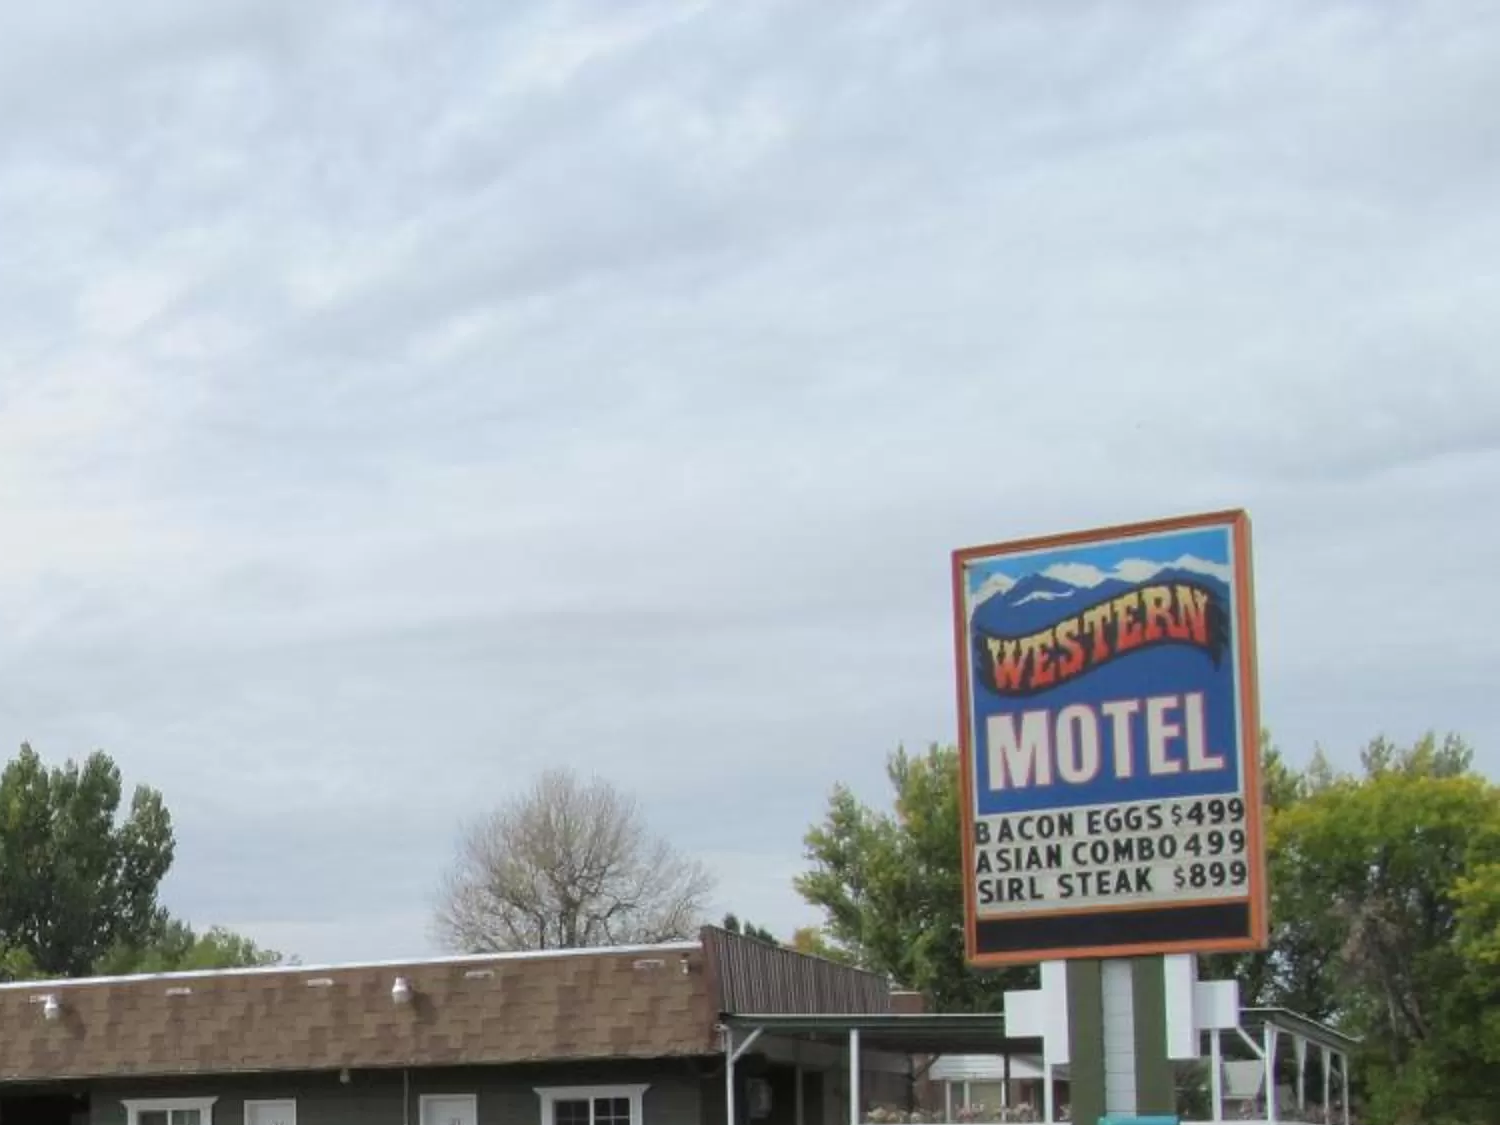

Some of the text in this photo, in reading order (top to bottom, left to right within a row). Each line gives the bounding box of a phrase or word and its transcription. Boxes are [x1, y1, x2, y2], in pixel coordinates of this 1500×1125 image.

[987, 583, 1209, 690] WESTERN
[986, 691, 1225, 791] MOTEL
[975, 798, 1245, 845] BACON EGGS $499
[975, 828, 1245, 874] ASIAN COMBO 499
[978, 860, 1247, 904] SIRL STEAK $899
